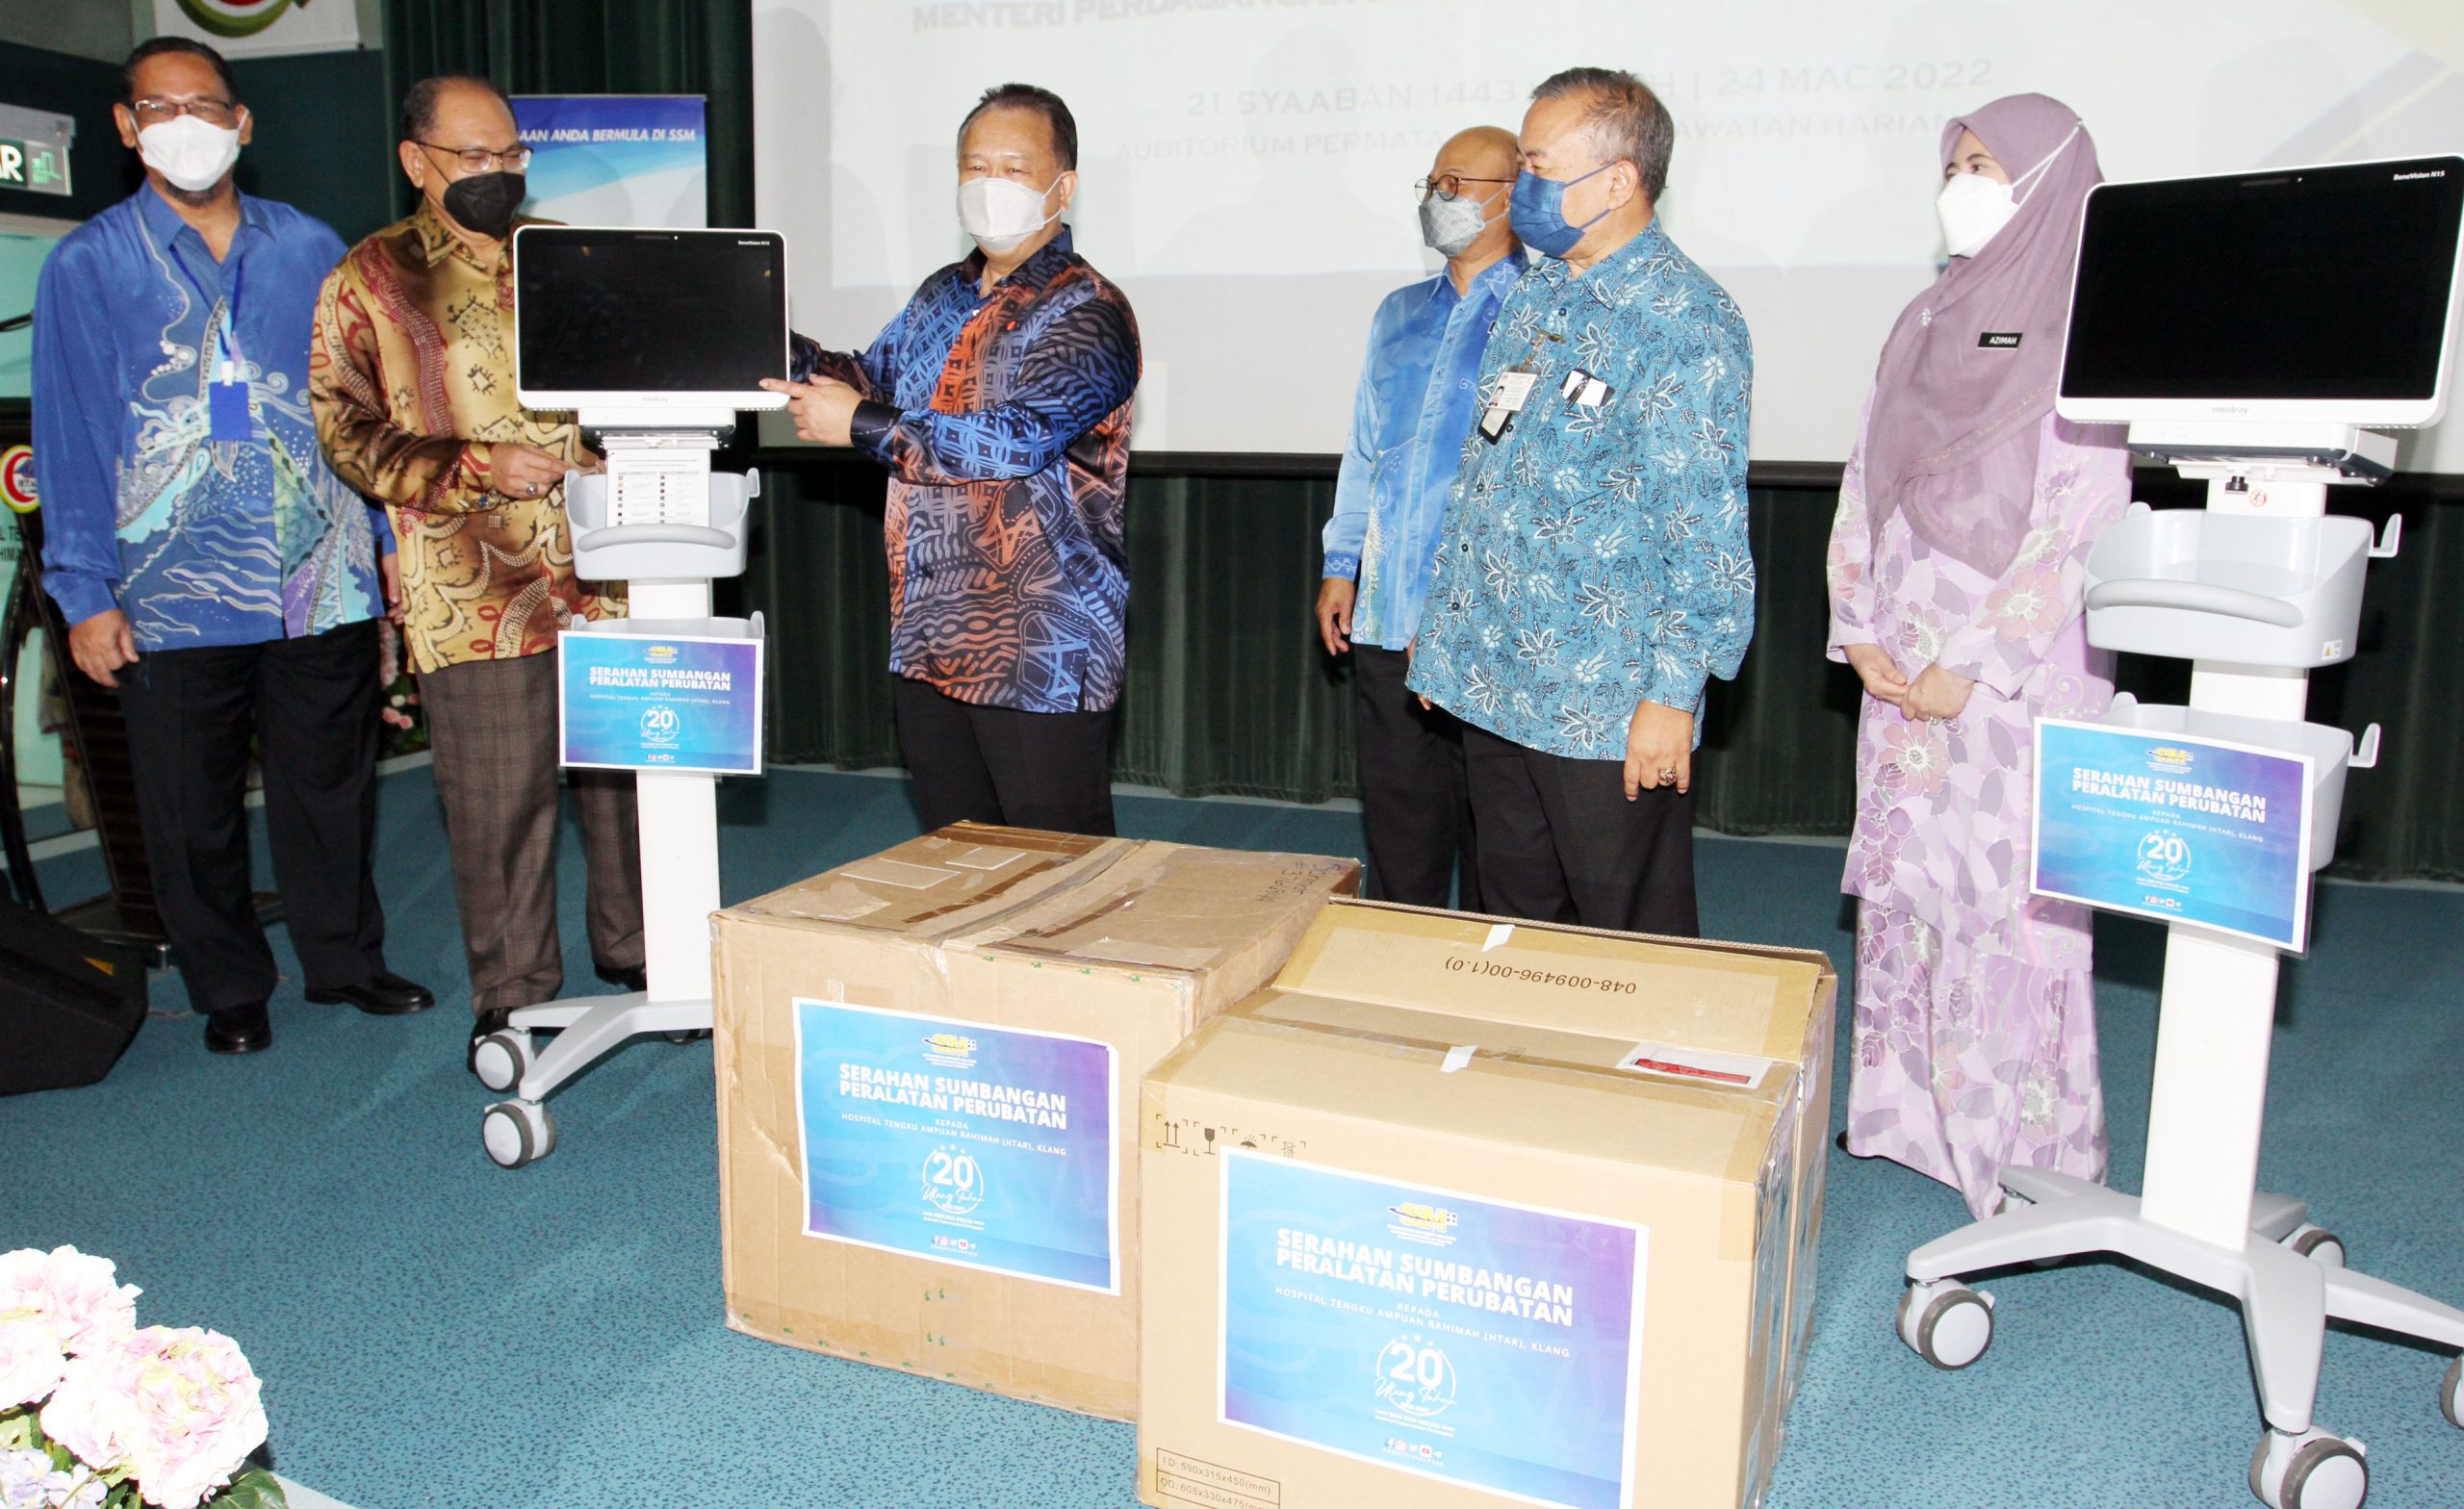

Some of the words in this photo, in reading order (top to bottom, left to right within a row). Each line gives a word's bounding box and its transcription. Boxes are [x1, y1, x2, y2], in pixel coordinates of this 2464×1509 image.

[913, 1, 1066, 32] MENTERI
[1186, 92, 1220, 116] 21
[1238, 85, 1412, 115] SYAABAN
[1432, 80, 1516, 107] 1443
[1717, 69, 1767, 96] 24
[1779, 64, 1872, 93] MAC
[1885, 59, 1993, 91] 2022
[551, 129, 589, 142] ANDA
[592, 129, 649, 141] BERMULA
[652, 128, 665, 141] DI
[668, 128, 696, 141] SSM
[1116, 136, 1295, 162] AUDITORIUM
[1989, 336, 2017, 345] AZIMAH
[589, 666, 648, 679] SERAHAN
[651, 669, 731, 682] SUMBANGAN
[589, 676, 658, 688] PERALATAN
[661, 678, 731, 691] PERUBATAN
[647, 710, 674, 729] 20
[2072, 767, 2149, 790] SERAHAN
[2155, 779, 2267, 809] SUMBANGAN
[2072, 780, 2165, 805] PERALATAN
[2169, 795, 2266, 824] PERUBATAN
[2146, 834, 2183, 861] 20
[839, 1063, 930, 1090] SERAHAN
[935, 1077, 1066, 1112] SUMBANGAN
[839, 1080, 948, 1111] PERALATAN
[953, 1097, 1066, 1130] PERUBATAN
[841, 1113, 882, 1126] HOSPITAL
[885, 1119, 918, 1132] TENGKU
[920, 1125, 957, 1138] AMPUAN
[960, 1131, 1000, 1144] RAHIMAH
[1037, 1143, 1066, 1156] KLANG
[935, 1118, 969, 1130] KEPADA
[933, 1152, 974, 1190] 20
[1276, 1228, 1393, 1269] SERAHAN
[1399, 1253, 1574, 1307] SUMBANGAN
[1276, 1247, 1415, 1294] PERALATAN
[1422, 1279, 1573, 1327] PERUBATAN
[1275, 1286, 1326, 1306] HOSPITAL
[1330, 1297, 1373, 1315] TENGKU
[1377, 1308, 1424, 1326] AMPUAN
[1428, 1319, 1480, 1340] RAHIMAH
[1531, 1341, 1570, 1358] KLANG
[1397, 1302, 1440, 1319] KEPADA
[1390, 1343, 1443, 1389] 20
